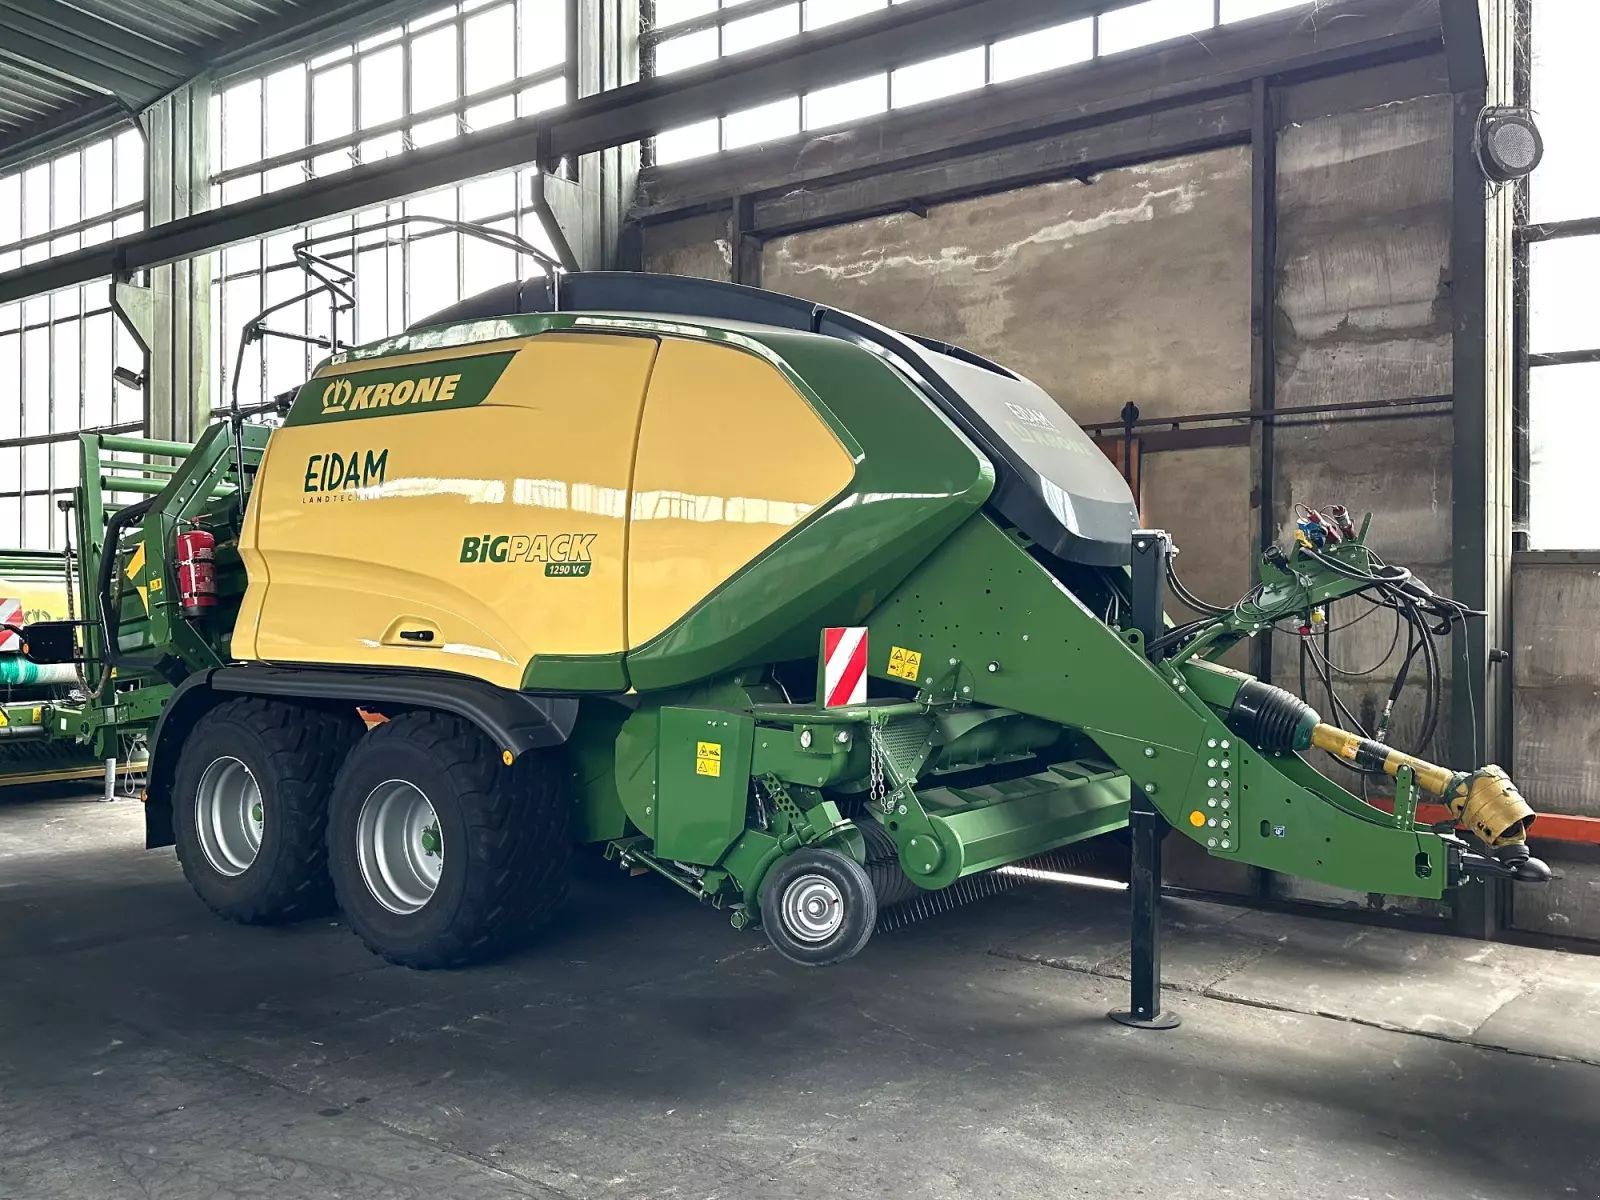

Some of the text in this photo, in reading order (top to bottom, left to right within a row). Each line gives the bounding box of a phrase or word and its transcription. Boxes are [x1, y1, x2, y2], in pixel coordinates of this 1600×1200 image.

[348, 374, 462, 411] KRONE
[304, 448, 389, 493] EIDAM
[459, 533, 598, 563] BiGPACK
[549, 565, 586, 575] 1290 VC
